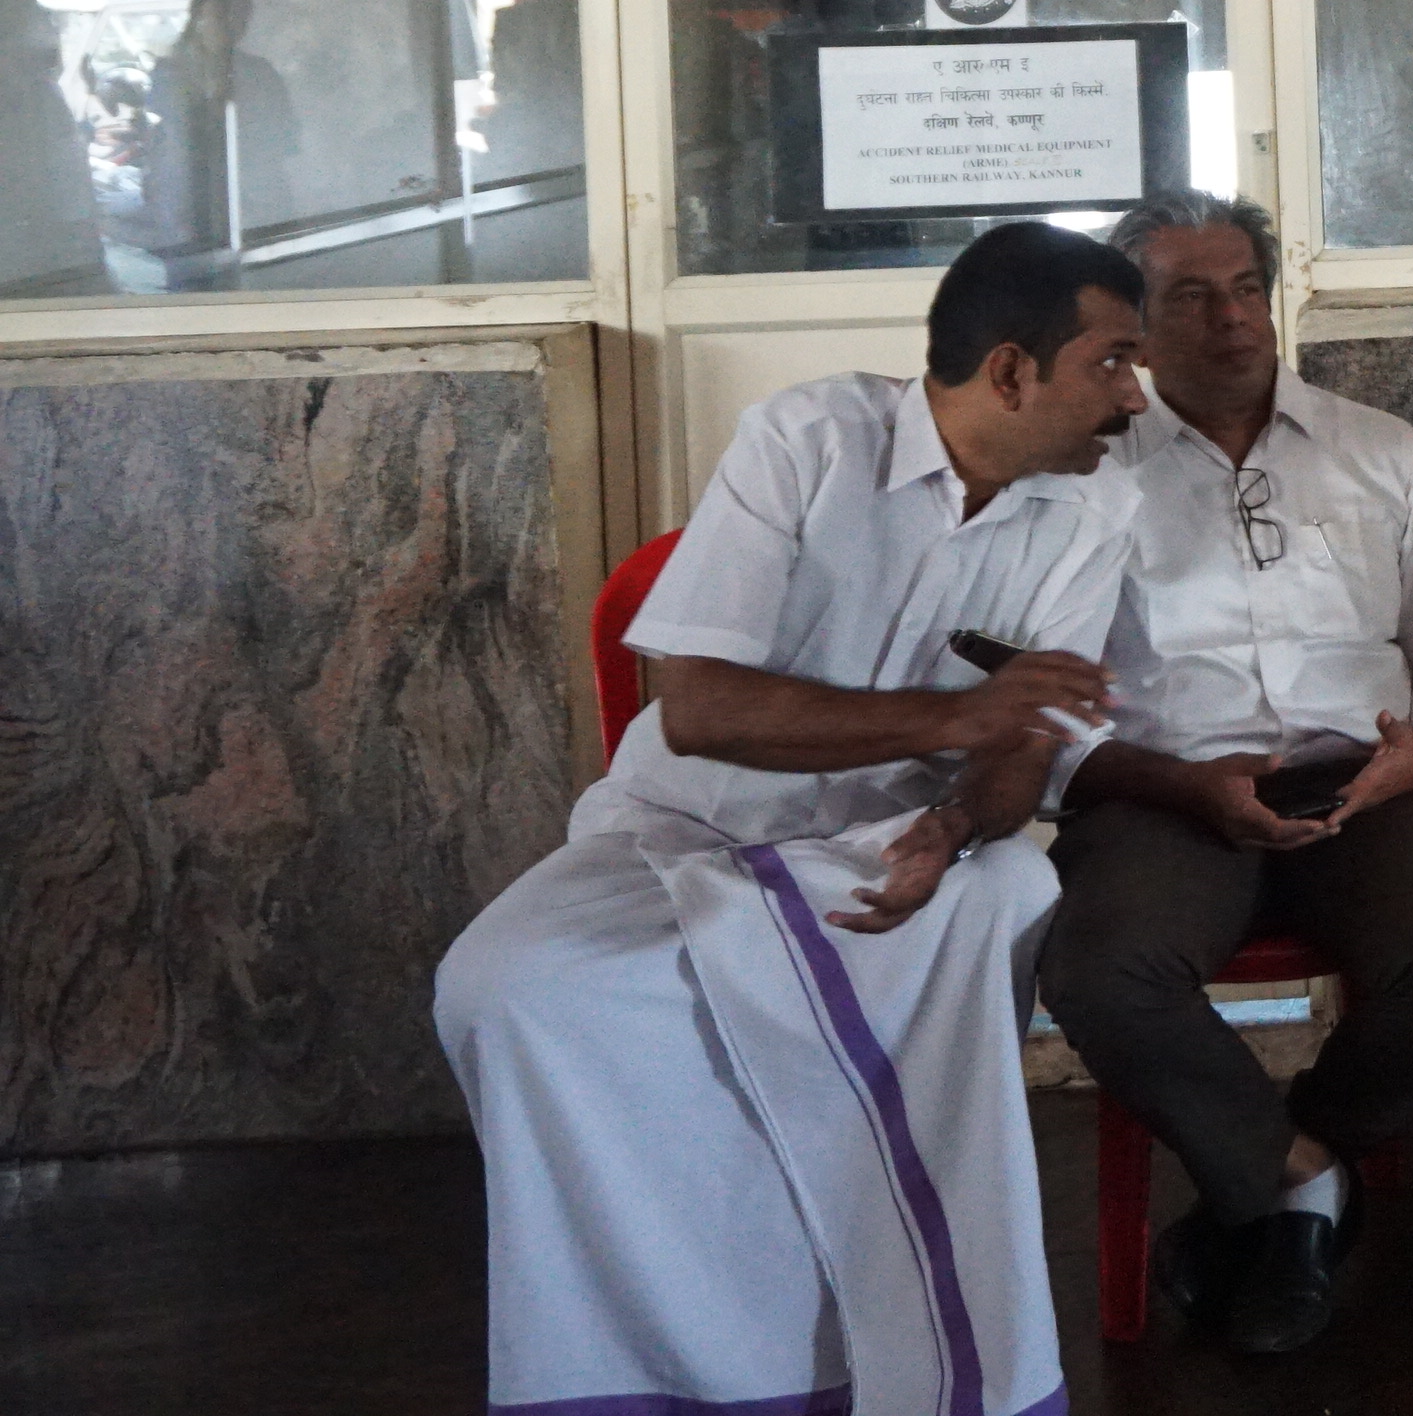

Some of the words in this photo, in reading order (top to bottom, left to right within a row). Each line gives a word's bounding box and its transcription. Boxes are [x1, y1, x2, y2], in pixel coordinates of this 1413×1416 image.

[857, 146, 922, 159] ACCIDENT
[926, 144, 973, 156] RELIEF
[976, 142, 1034, 154] MEDICAL
[1037, 139, 1113, 153] EQUIPMENT
[962, 157, 1009, 169] (ARME)
[889, 171, 959, 185] SOUTHERN
[1029, 168, 1083, 180] KANNUR
